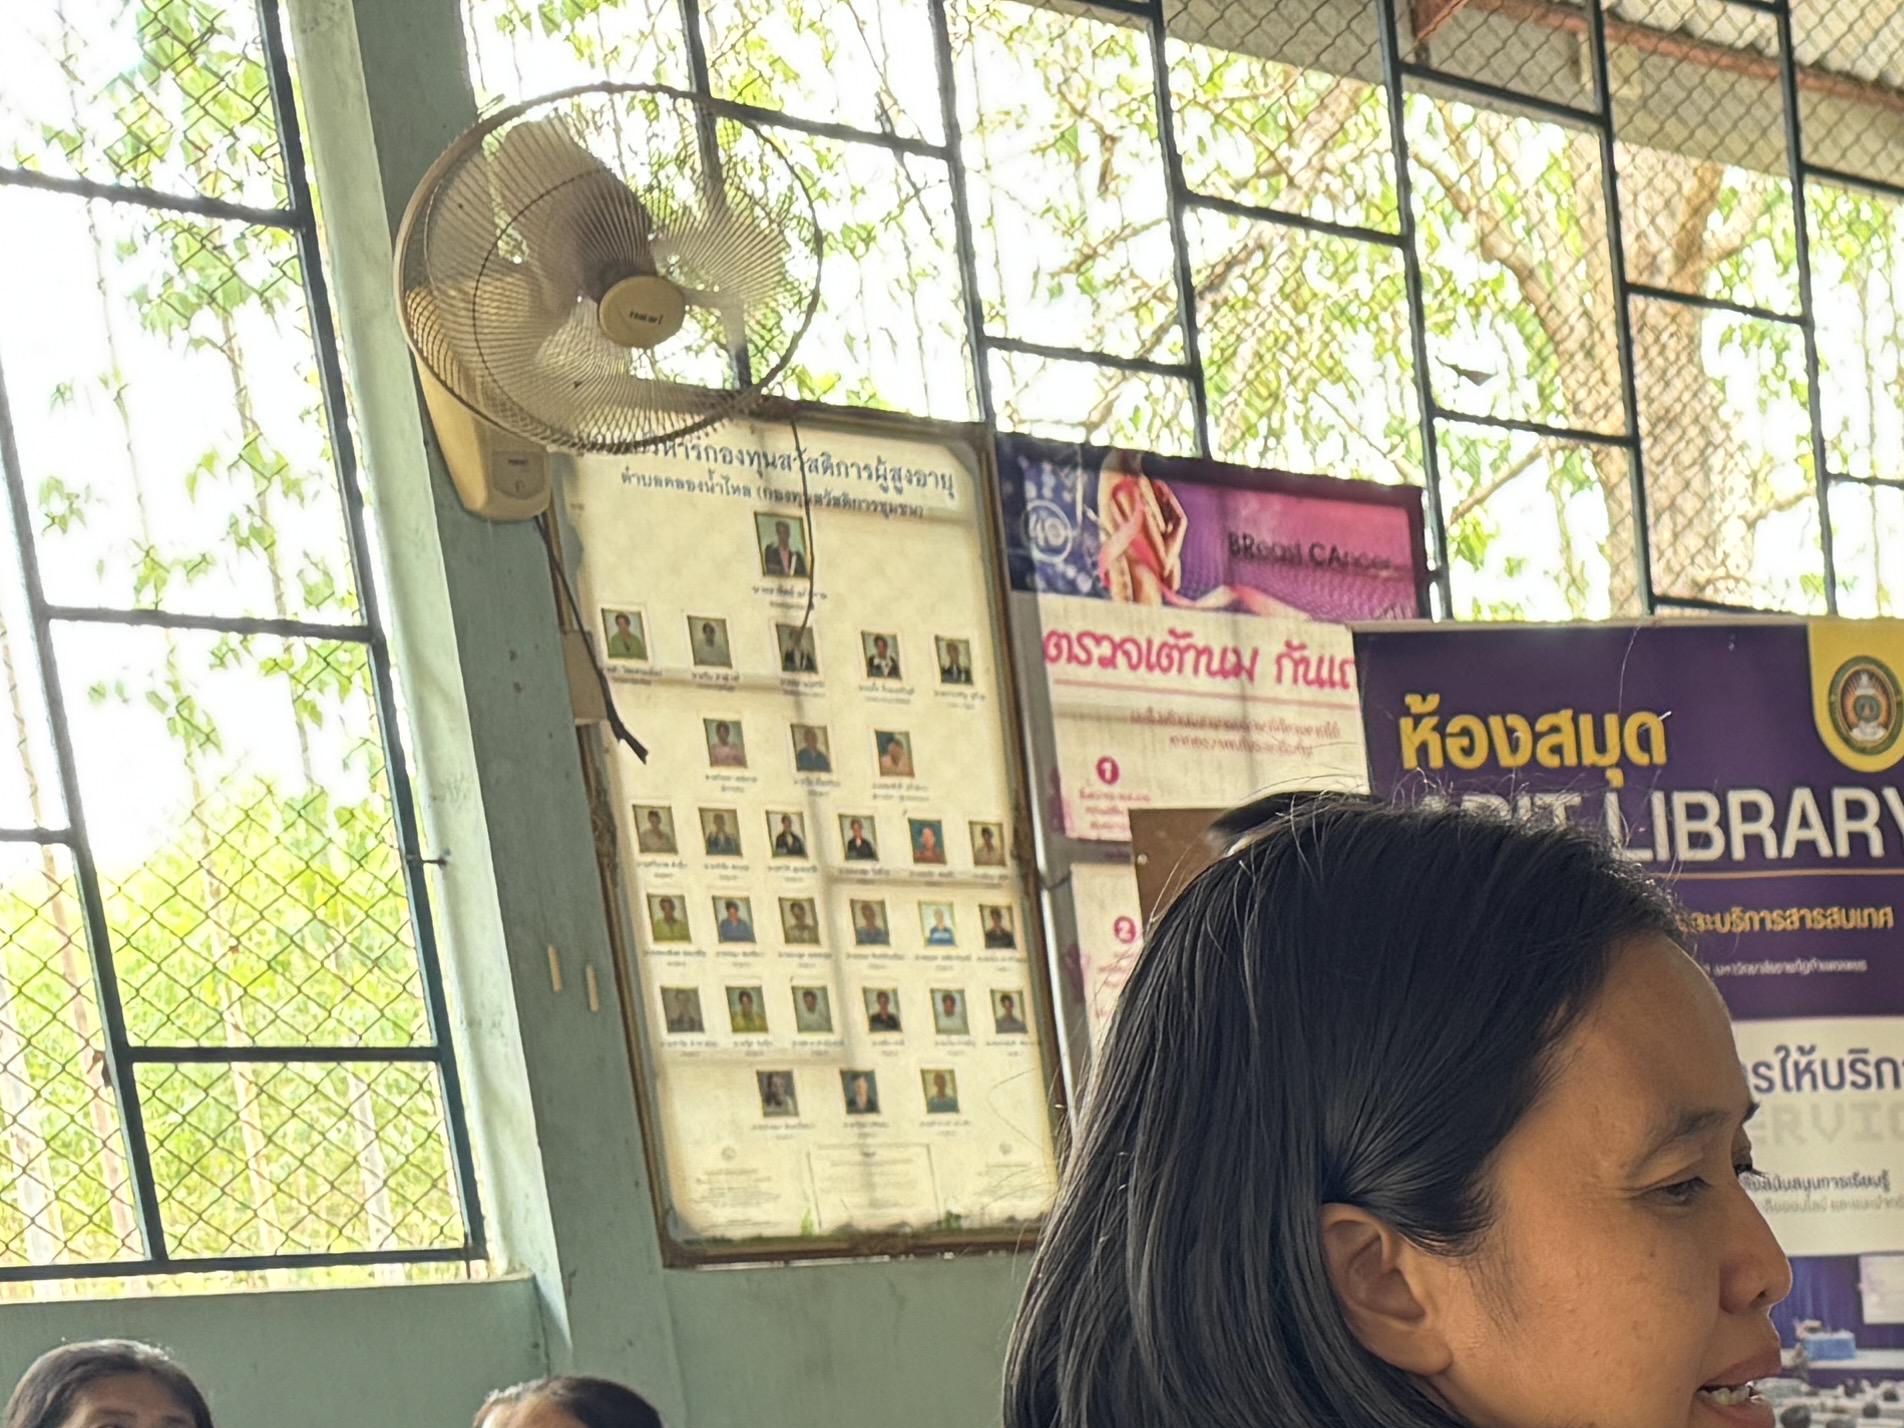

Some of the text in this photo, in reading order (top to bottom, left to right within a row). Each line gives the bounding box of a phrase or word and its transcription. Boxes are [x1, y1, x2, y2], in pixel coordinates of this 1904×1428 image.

[1044, 627, 1259, 685] ตรวจเต้านม
[1399, 693, 1668, 789] ห้องสมุด
